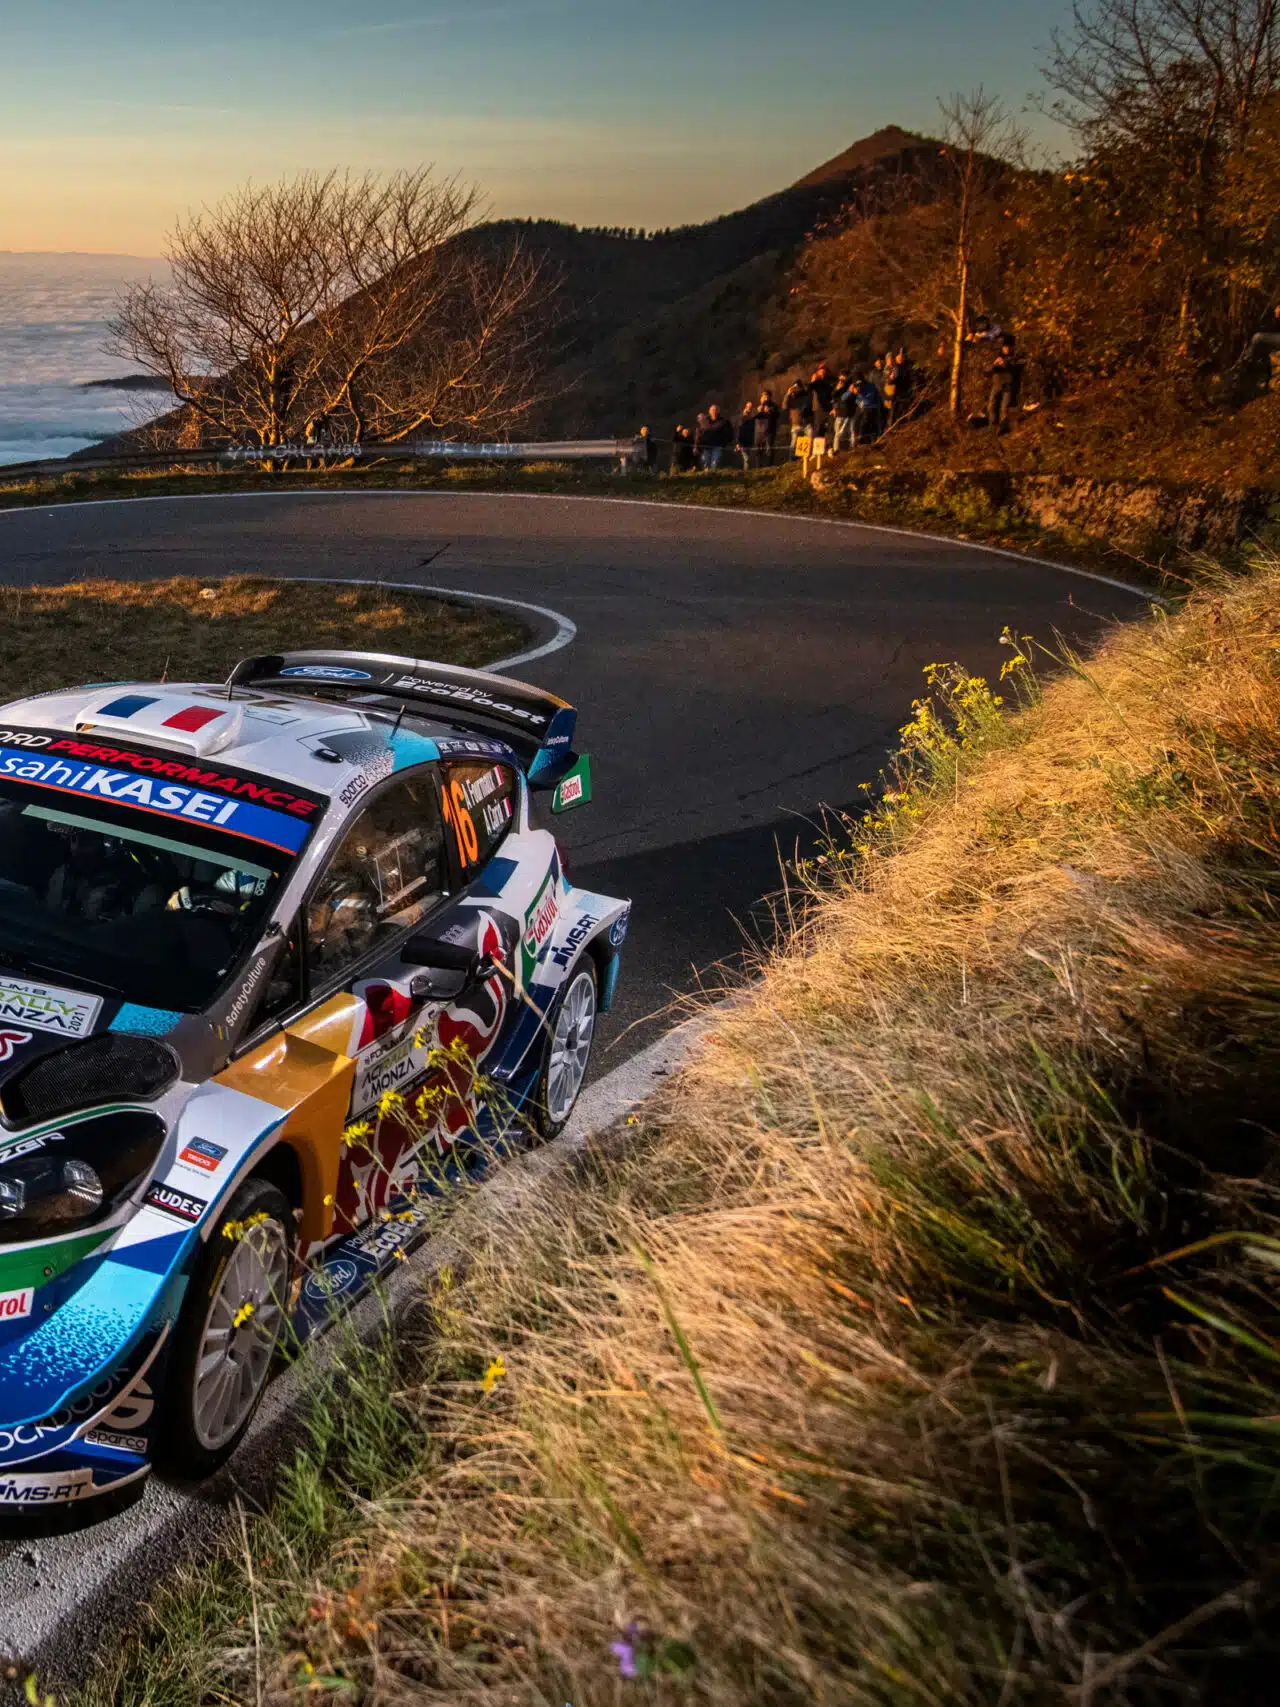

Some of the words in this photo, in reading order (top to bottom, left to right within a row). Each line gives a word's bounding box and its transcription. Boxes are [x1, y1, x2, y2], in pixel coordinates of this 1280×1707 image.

[401, 675, 470, 696] Powered
[473, 688, 493, 698] by
[47, 739, 319, 816] PERFORMANCE
[339, 774, 367, 806] sparco
[441, 780, 478, 868] 16
[532, 895, 559, 944] Castrol
[225, 957, 266, 1027] SafetyCulture
[69, 1011, 81, 1032] 2021
[370, 1057, 415, 1098] MONZA
[147, 1187, 203, 1217] AUDES
[86, 1429, 147, 1449] sparco
[5, 1481, 88, 1500] MS-RT
